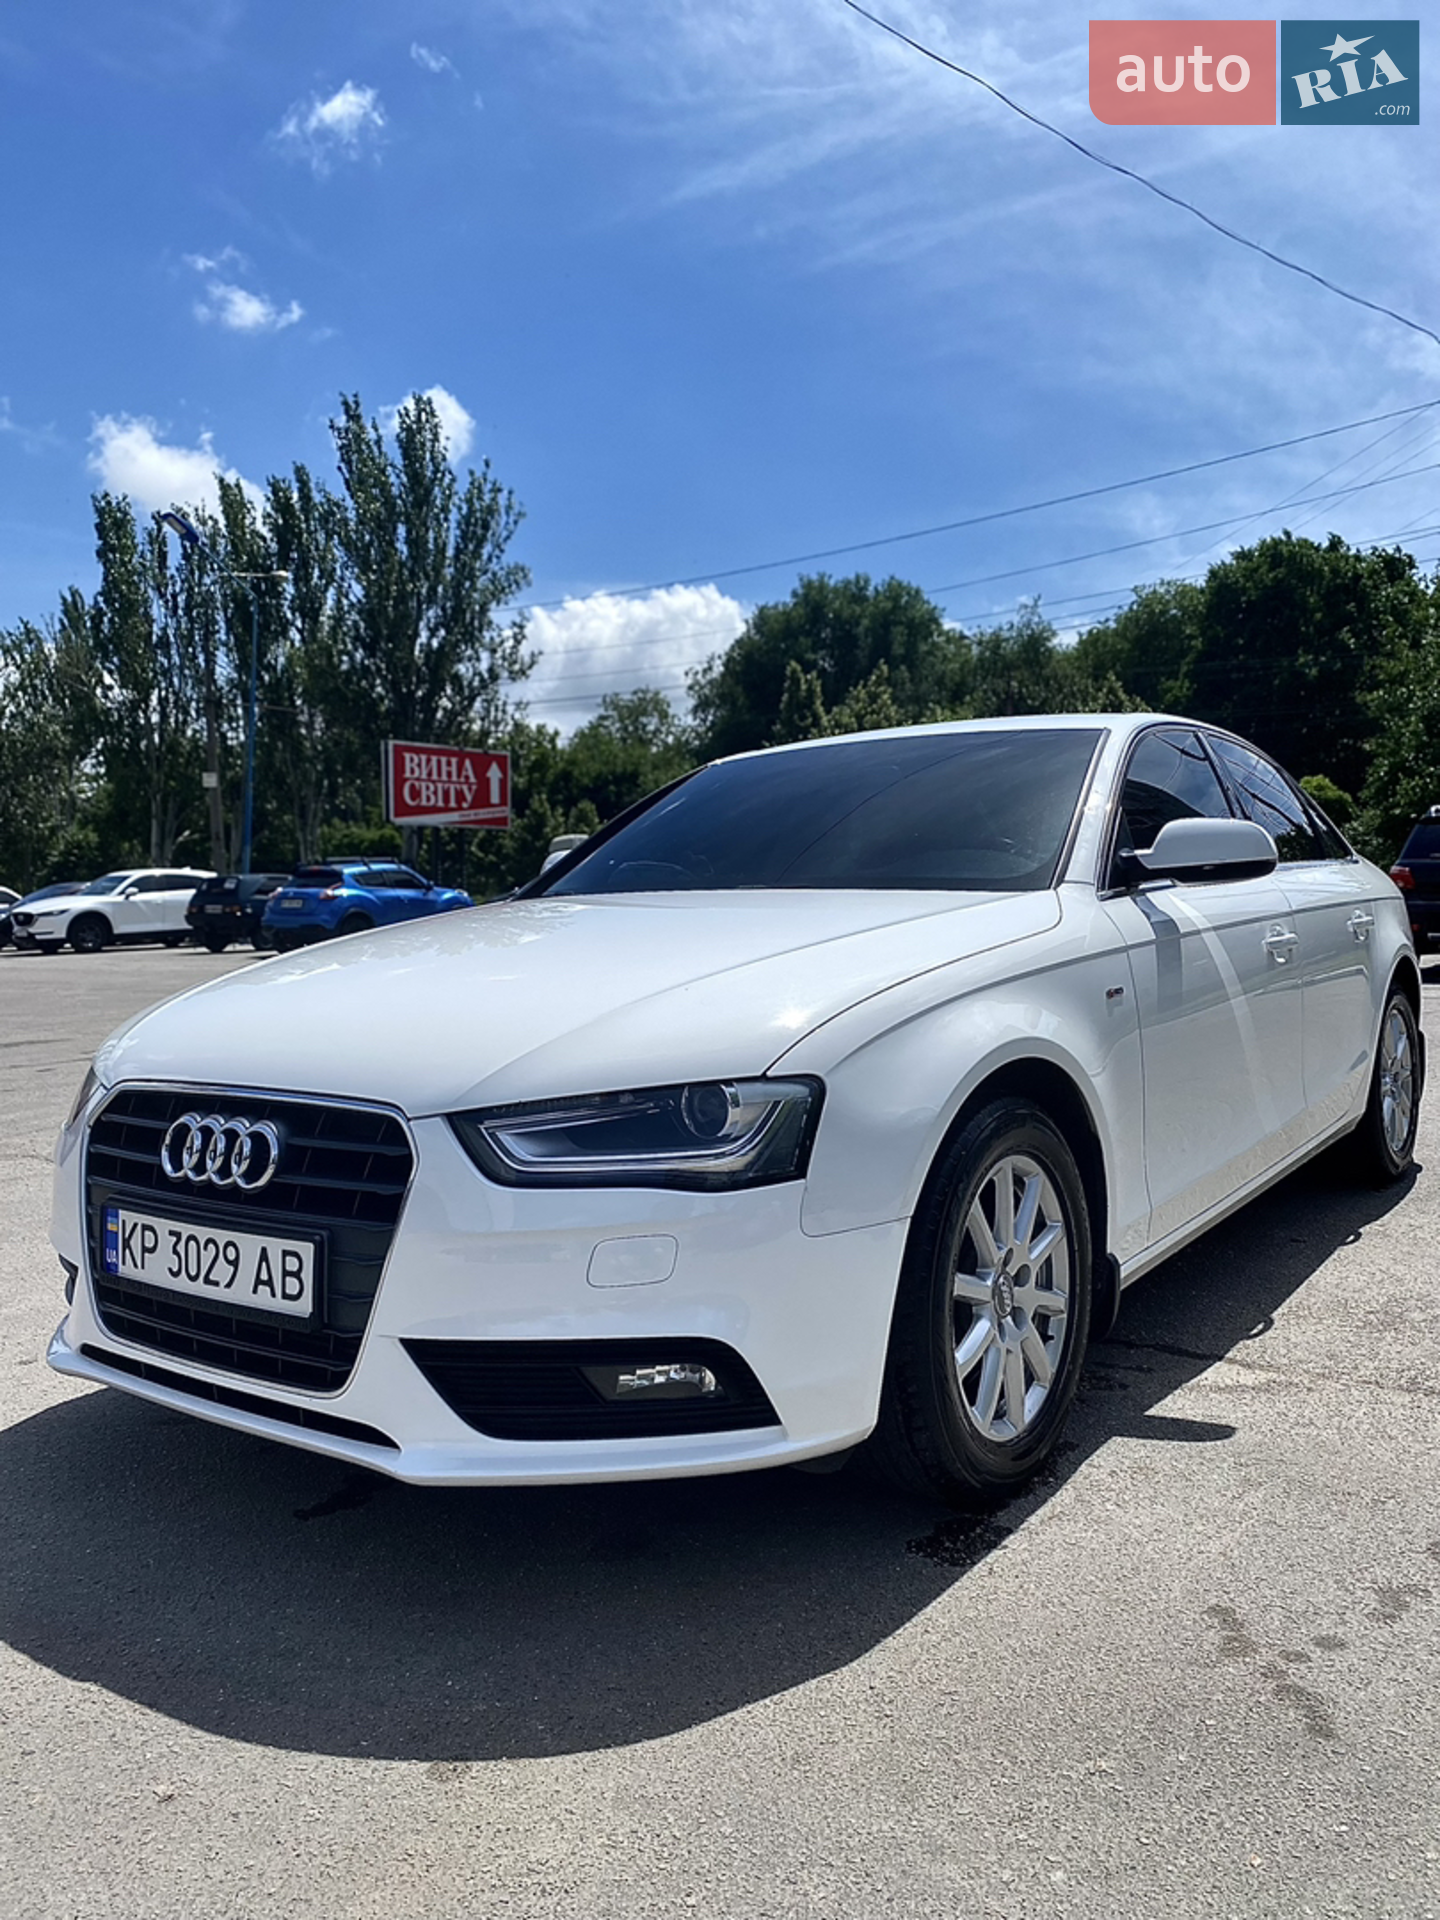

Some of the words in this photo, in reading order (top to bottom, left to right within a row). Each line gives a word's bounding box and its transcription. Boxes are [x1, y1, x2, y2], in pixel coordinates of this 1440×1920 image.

[402, 751, 477, 783] ВИНА
[402, 779, 477, 809] СВІТУ
[105, 1247, 118, 1264] UA
[121, 1218, 159, 1270] KP
[167, 1229, 241, 1289] 3029
[252, 1246, 305, 1301] AB
